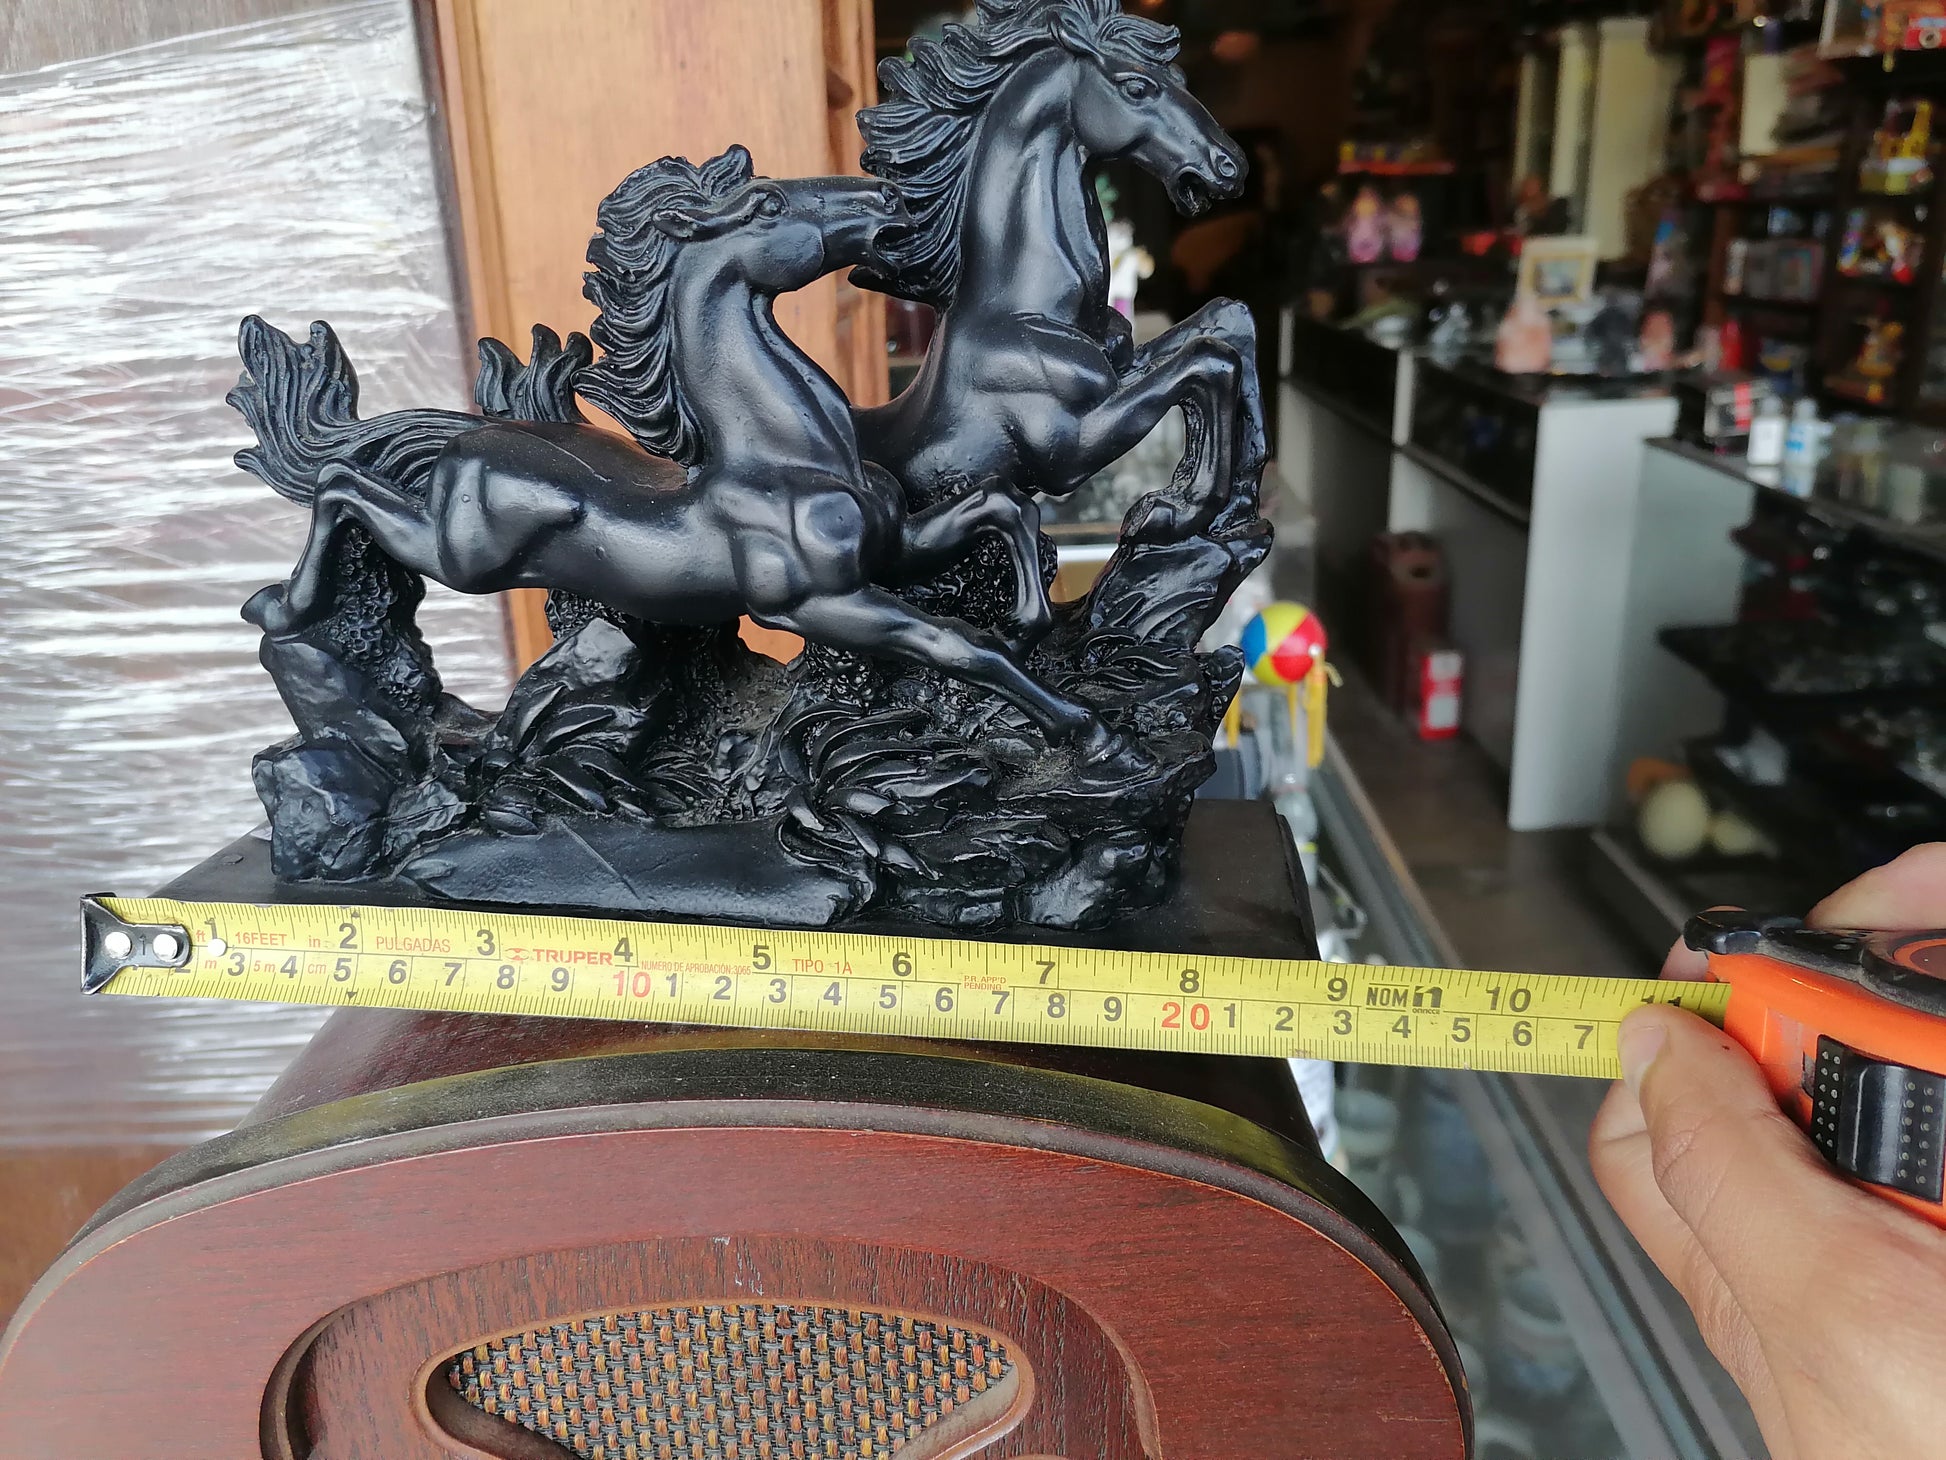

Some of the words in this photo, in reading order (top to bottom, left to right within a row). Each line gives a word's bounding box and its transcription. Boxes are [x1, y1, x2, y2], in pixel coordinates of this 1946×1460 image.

[195, 929, 206, 943] ft
[204, 917, 218, 939] 1
[235, 931, 287, 946] 16FEET
[339, 922, 358, 949] 2
[308, 934, 321, 948] in
[376, 936, 451, 953] PULGADAS
[477, 929, 496, 956] 3
[614, 937, 633, 962] 4
[204, 959, 217, 969] m
[227, 952, 246, 976] 3
[253, 960, 261, 973] 5
[264, 963, 276, 973] m
[280, 955, 298, 979] 4
[307, 962, 327, 975] cm
[333, 957, 352, 982] 5
[532, 948, 614, 966] TRUPER
[641, 960, 673, 972] NUMERO
[674, 962, 684, 972] DE
[752, 944, 772, 970] 5
[792, 958, 824, 973] TIPO
[834, 961, 853, 975] 1A
[892, 952, 912, 977] 6
[388, 960, 407, 985] 6
[444, 962, 462, 987] 7
[496, 965, 515, 990] 8
[551, 967, 570, 992] 9
[613, 970, 652, 998] 10
[666, 972, 677, 997] 1
[1036, 960, 1056, 984] 7
[1179, 968, 1200, 993] 8
[713, 975, 732, 1000] 2
[768, 978, 787, 1003] 3
[823, 982, 842, 1006] 4
[879, 984, 897, 1009] 5
[964, 982, 1002, 991] PENDING
[1327, 977, 1348, 1002] 9
[1366, 986, 1409, 1008] NOM
[935, 987, 954, 1012] 6
[991, 991, 1010, 1015] 7
[1047, 993, 1066, 1018] 8
[1103, 996, 1123, 1021] 9
[1485, 986, 1532, 1013] 10
[1161, 1001, 1210, 1030] 20
[1223, 1003, 1236, 1028] 1
[1274, 1006, 1294, 1031] 2
[1333, 1009, 1352, 1035] 3
[1391, 1015, 1411, 1039] 4
[1451, 1017, 1471, 1043] 5
[1512, 1020, 1532, 1046] 6
[1574, 1025, 1593, 1050] 7
